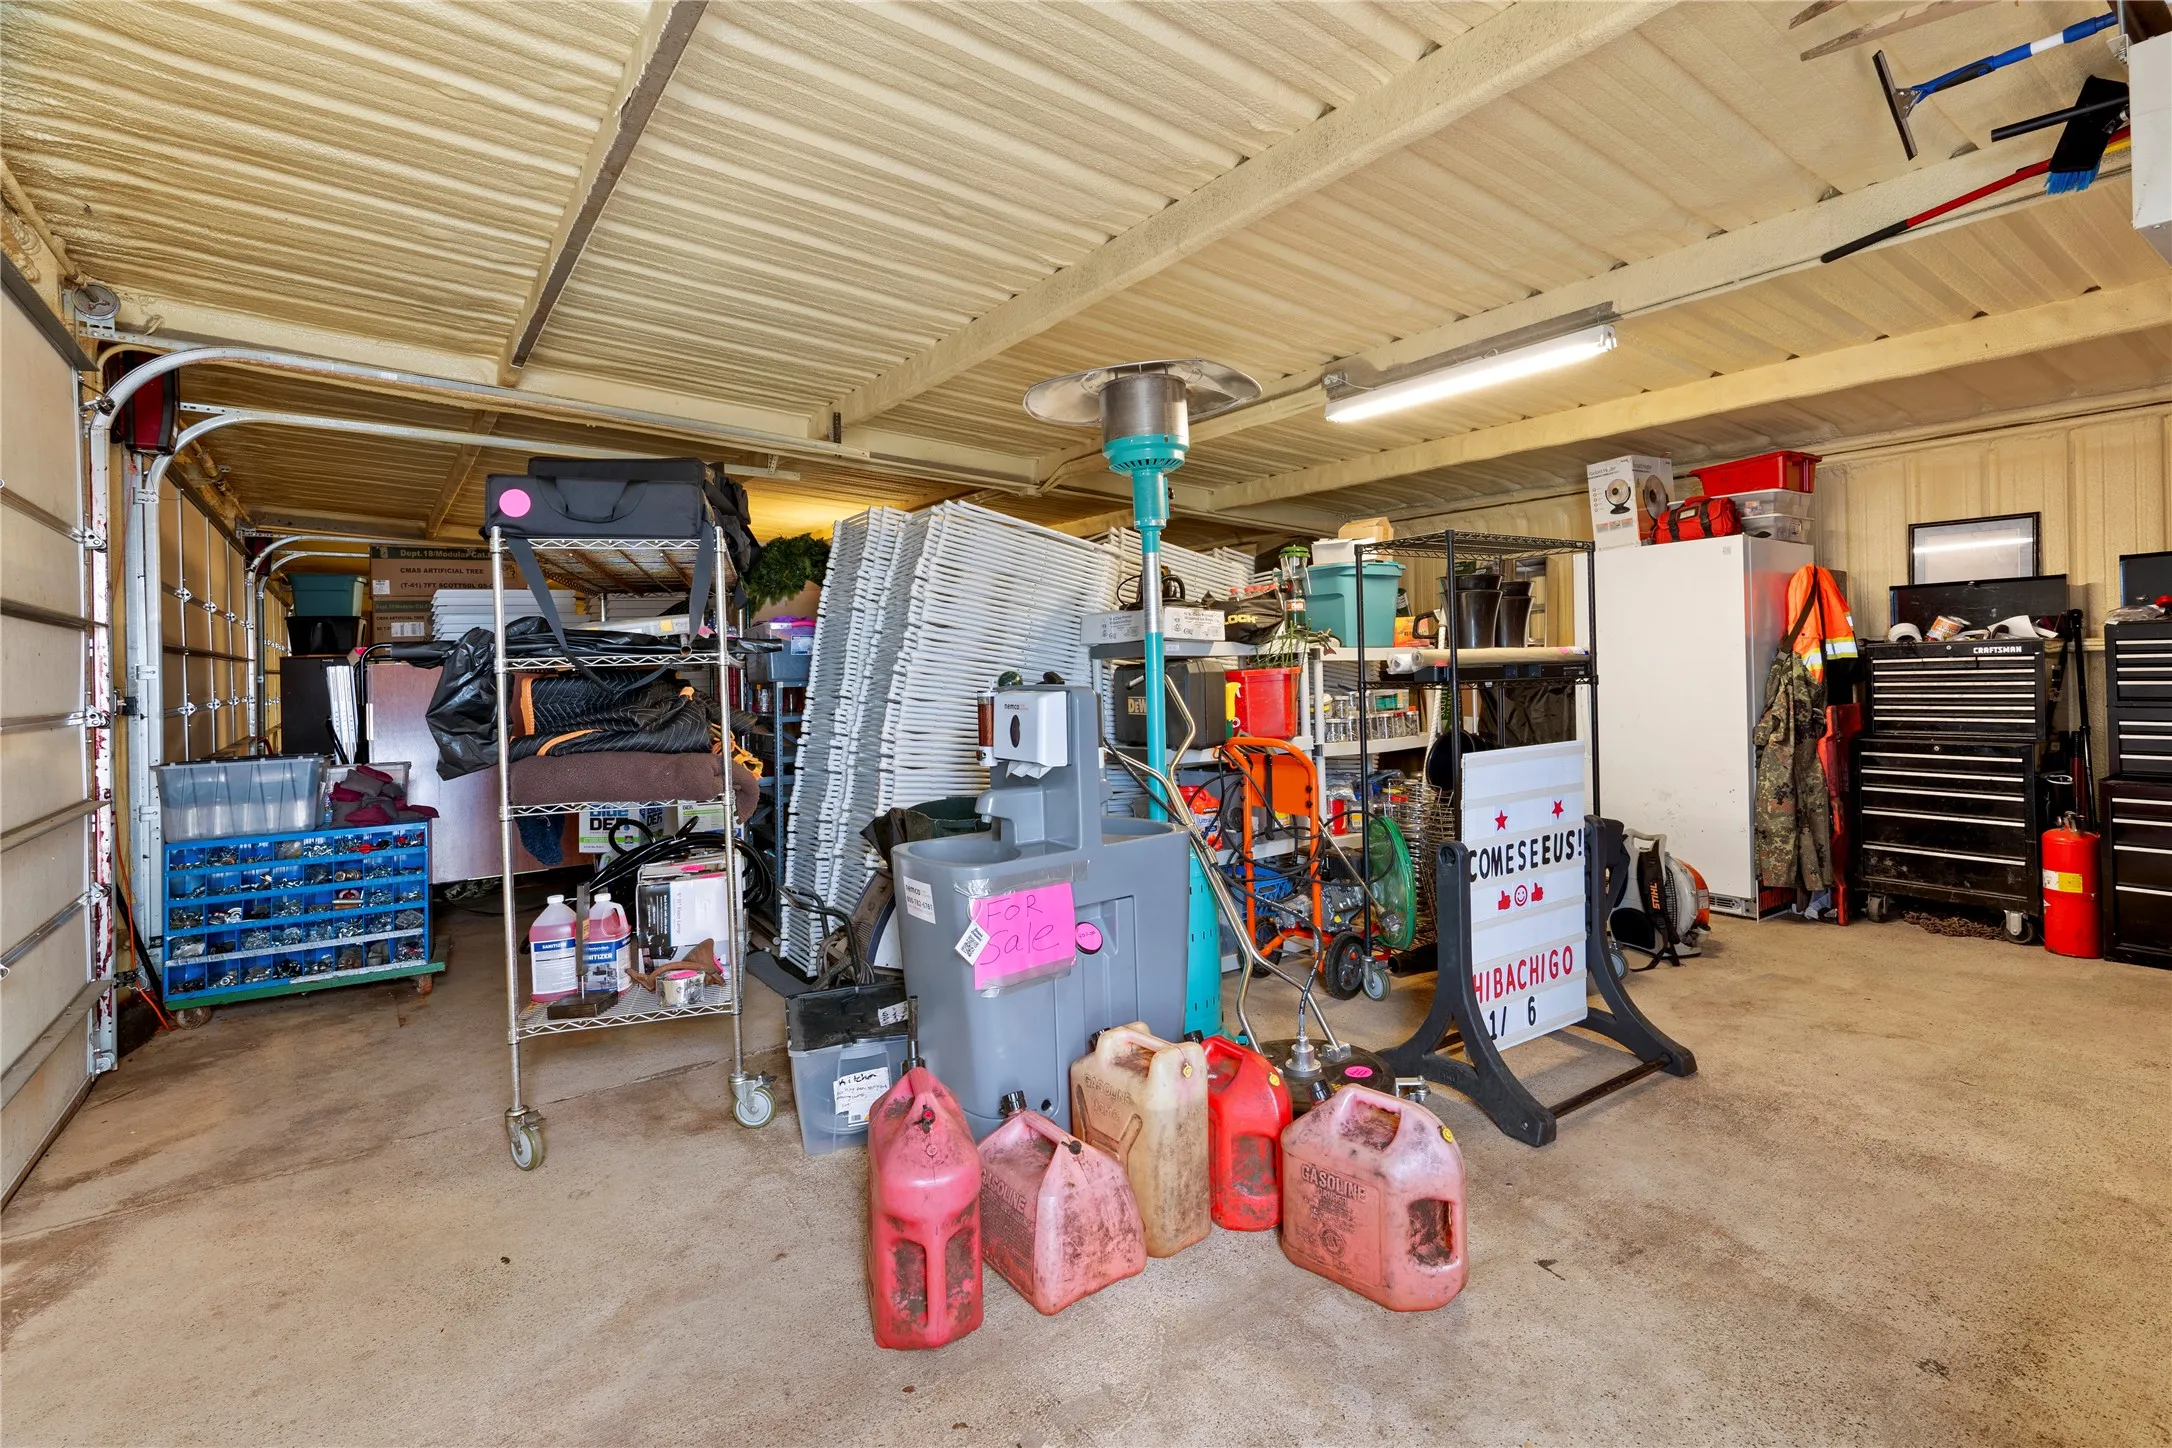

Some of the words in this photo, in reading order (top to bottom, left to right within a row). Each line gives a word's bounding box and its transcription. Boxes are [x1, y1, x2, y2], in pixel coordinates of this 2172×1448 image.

[1973, 645, 2022, 654] CRAFTSMAN
[1127, 698, 1147, 714] DEW
[986, 893, 1044, 930] FOR
[1649, 882, 1661, 910] STIHL
[542, 942, 567, 950] SANITIZER
[587, 953, 613, 961] NITIZER
[979, 921, 1060, 966] Sale
[1527, 995, 1537, 1027] 6
[1084, 1073, 1134, 1106] GASOLINE
[981, 1167, 1027, 1214] GASOLINE
[1301, 1162, 1367, 1204] GASOLINE
